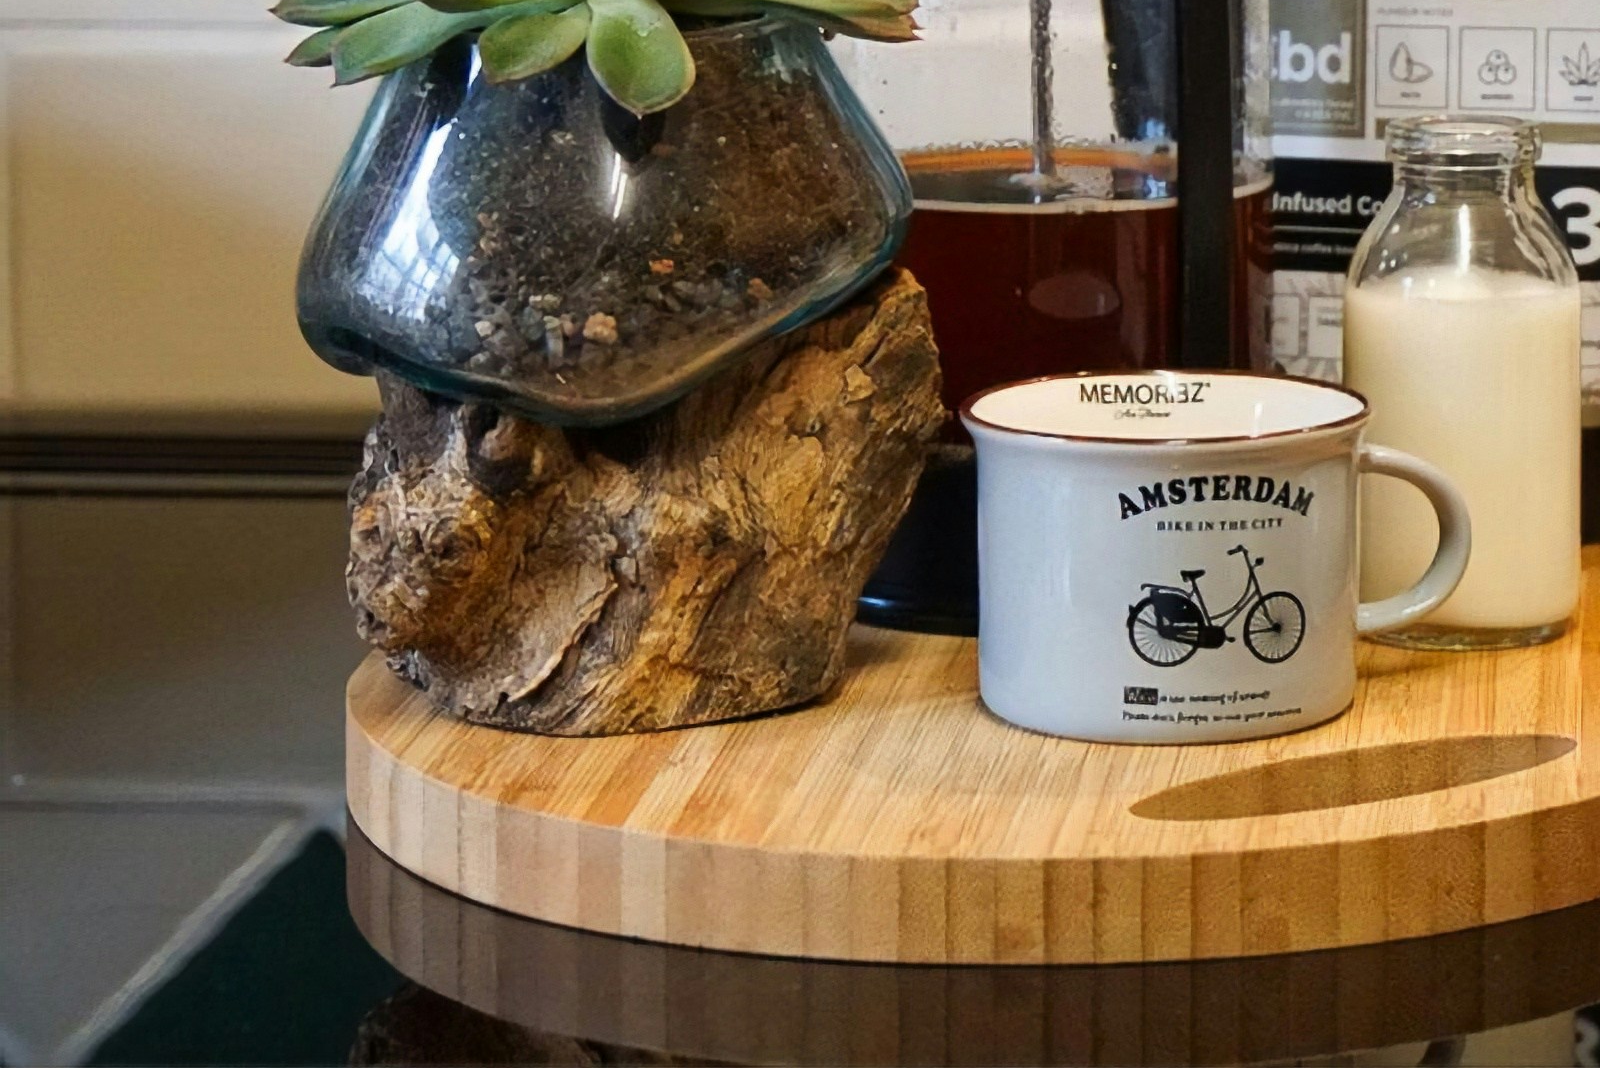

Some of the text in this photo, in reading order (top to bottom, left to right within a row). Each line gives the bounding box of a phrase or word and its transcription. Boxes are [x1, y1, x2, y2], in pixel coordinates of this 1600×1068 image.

[1271, 30, 1351, 84] bd
[1272, 191, 1352, 215] Infused
[1118, 475, 1315, 520] AMSTERDAM
[1156, 520, 1194, 532] BIKE
[1198, 521, 1215, 531] IN
[1219, 520, 1249, 531] THE
